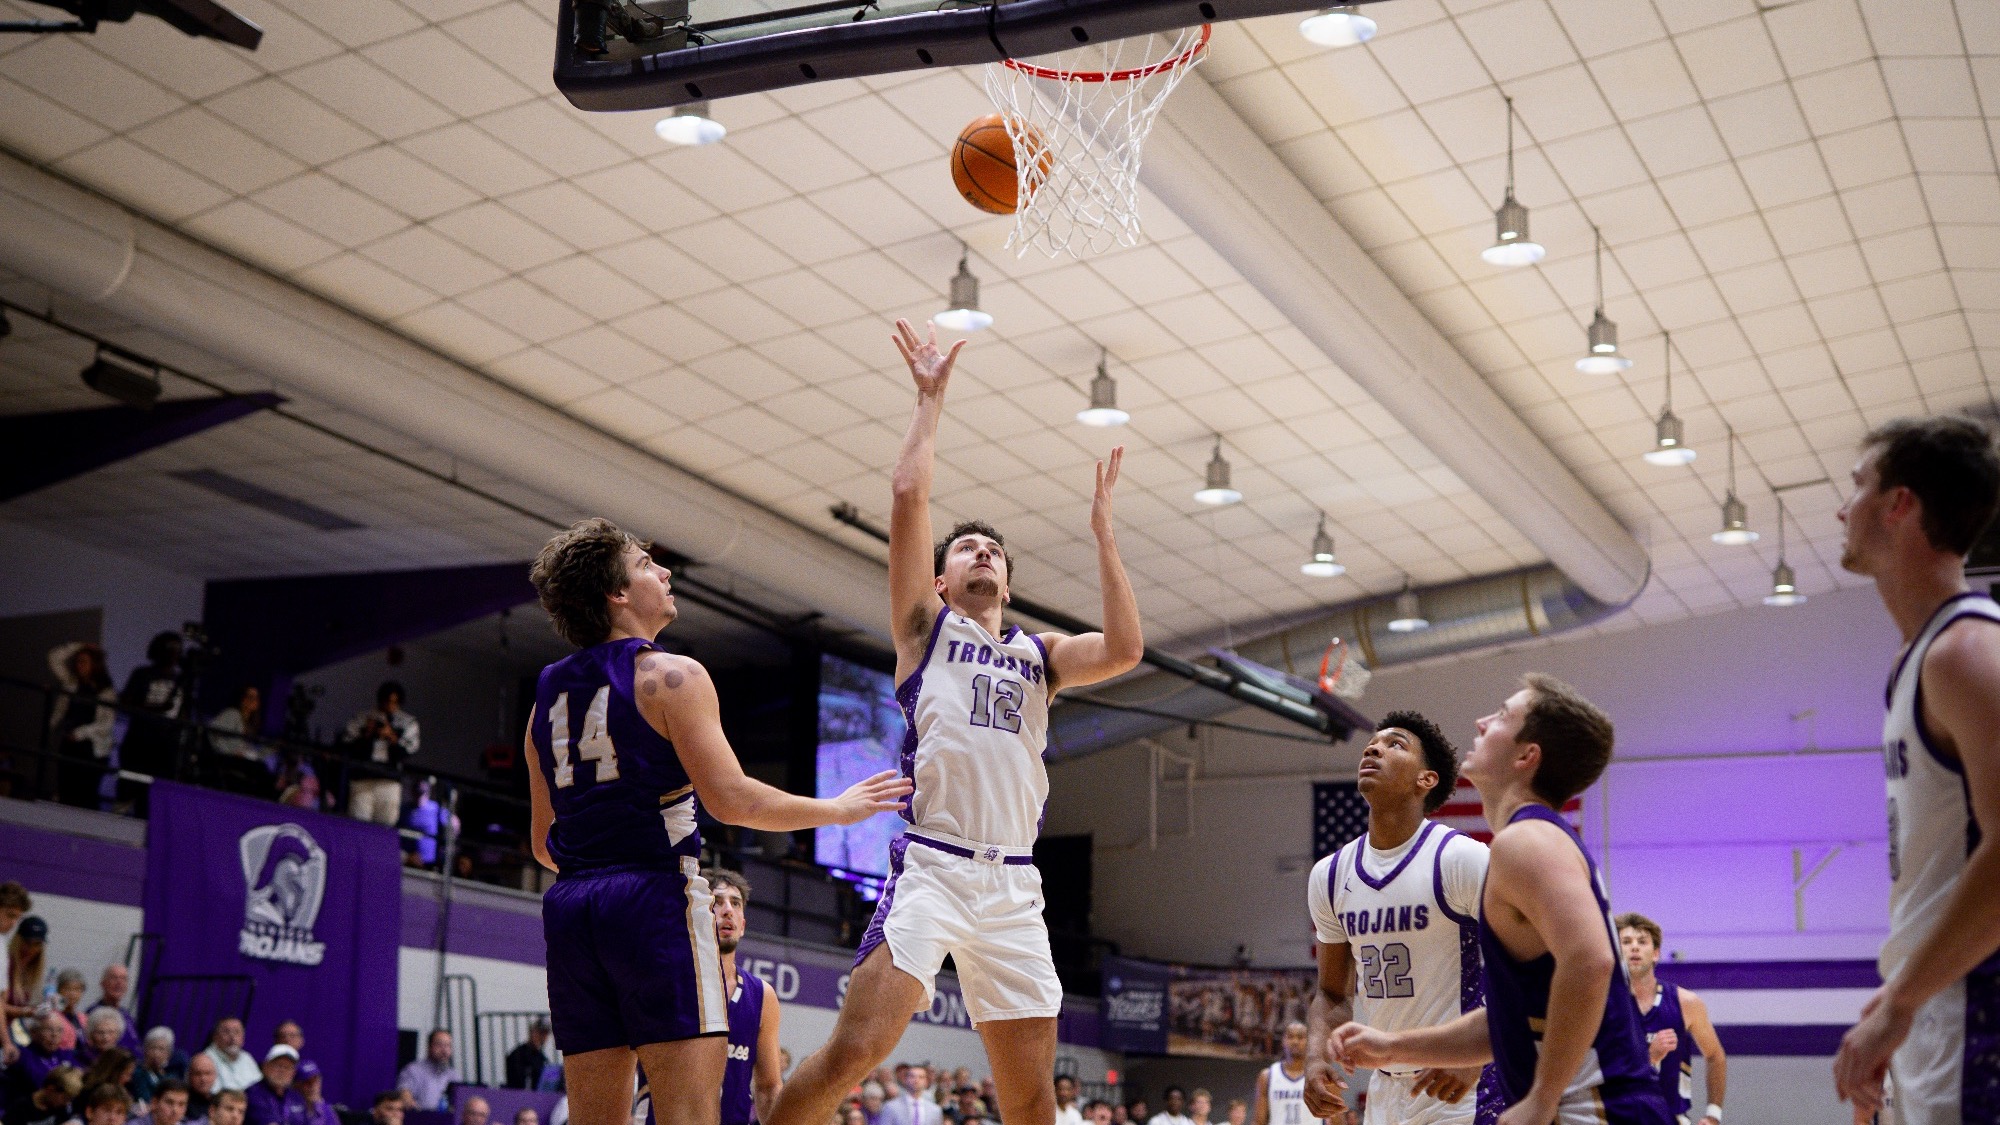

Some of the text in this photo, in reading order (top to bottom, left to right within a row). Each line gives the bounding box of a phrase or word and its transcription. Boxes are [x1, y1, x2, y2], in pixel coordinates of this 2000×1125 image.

[946, 640, 1043, 685] TROJANS
[970, 673, 1023, 734] 12
[548, 684, 620, 789] 14
[1338, 904, 1429, 937] TROJANS
[1361, 942, 1414, 999] 22
